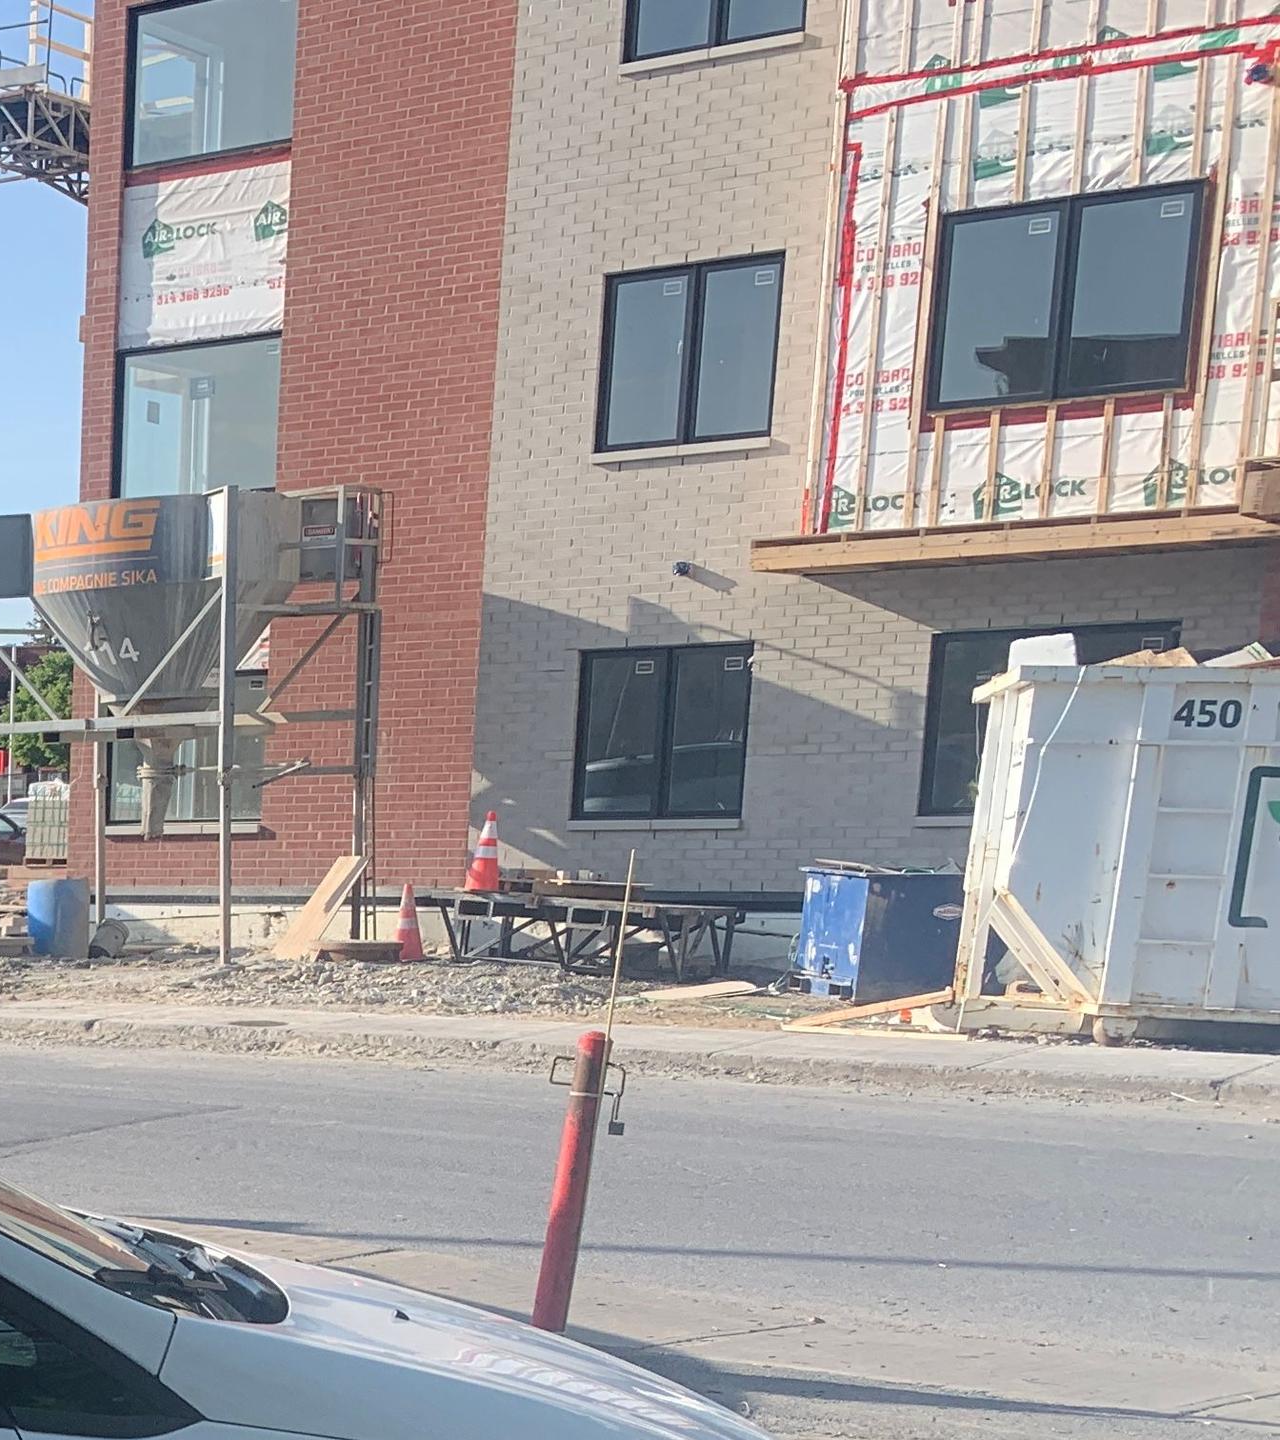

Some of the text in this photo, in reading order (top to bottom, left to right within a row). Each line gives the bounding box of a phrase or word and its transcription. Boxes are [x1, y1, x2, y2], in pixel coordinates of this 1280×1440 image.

[144, 221, 218, 244] AIR-LOCK
[35, 500, 161, 549] KING
[47, 571, 118, 594] COMPAGNIE
[121, 568, 158, 586] SIKA
[1173, 699, 1243, 729] 450
